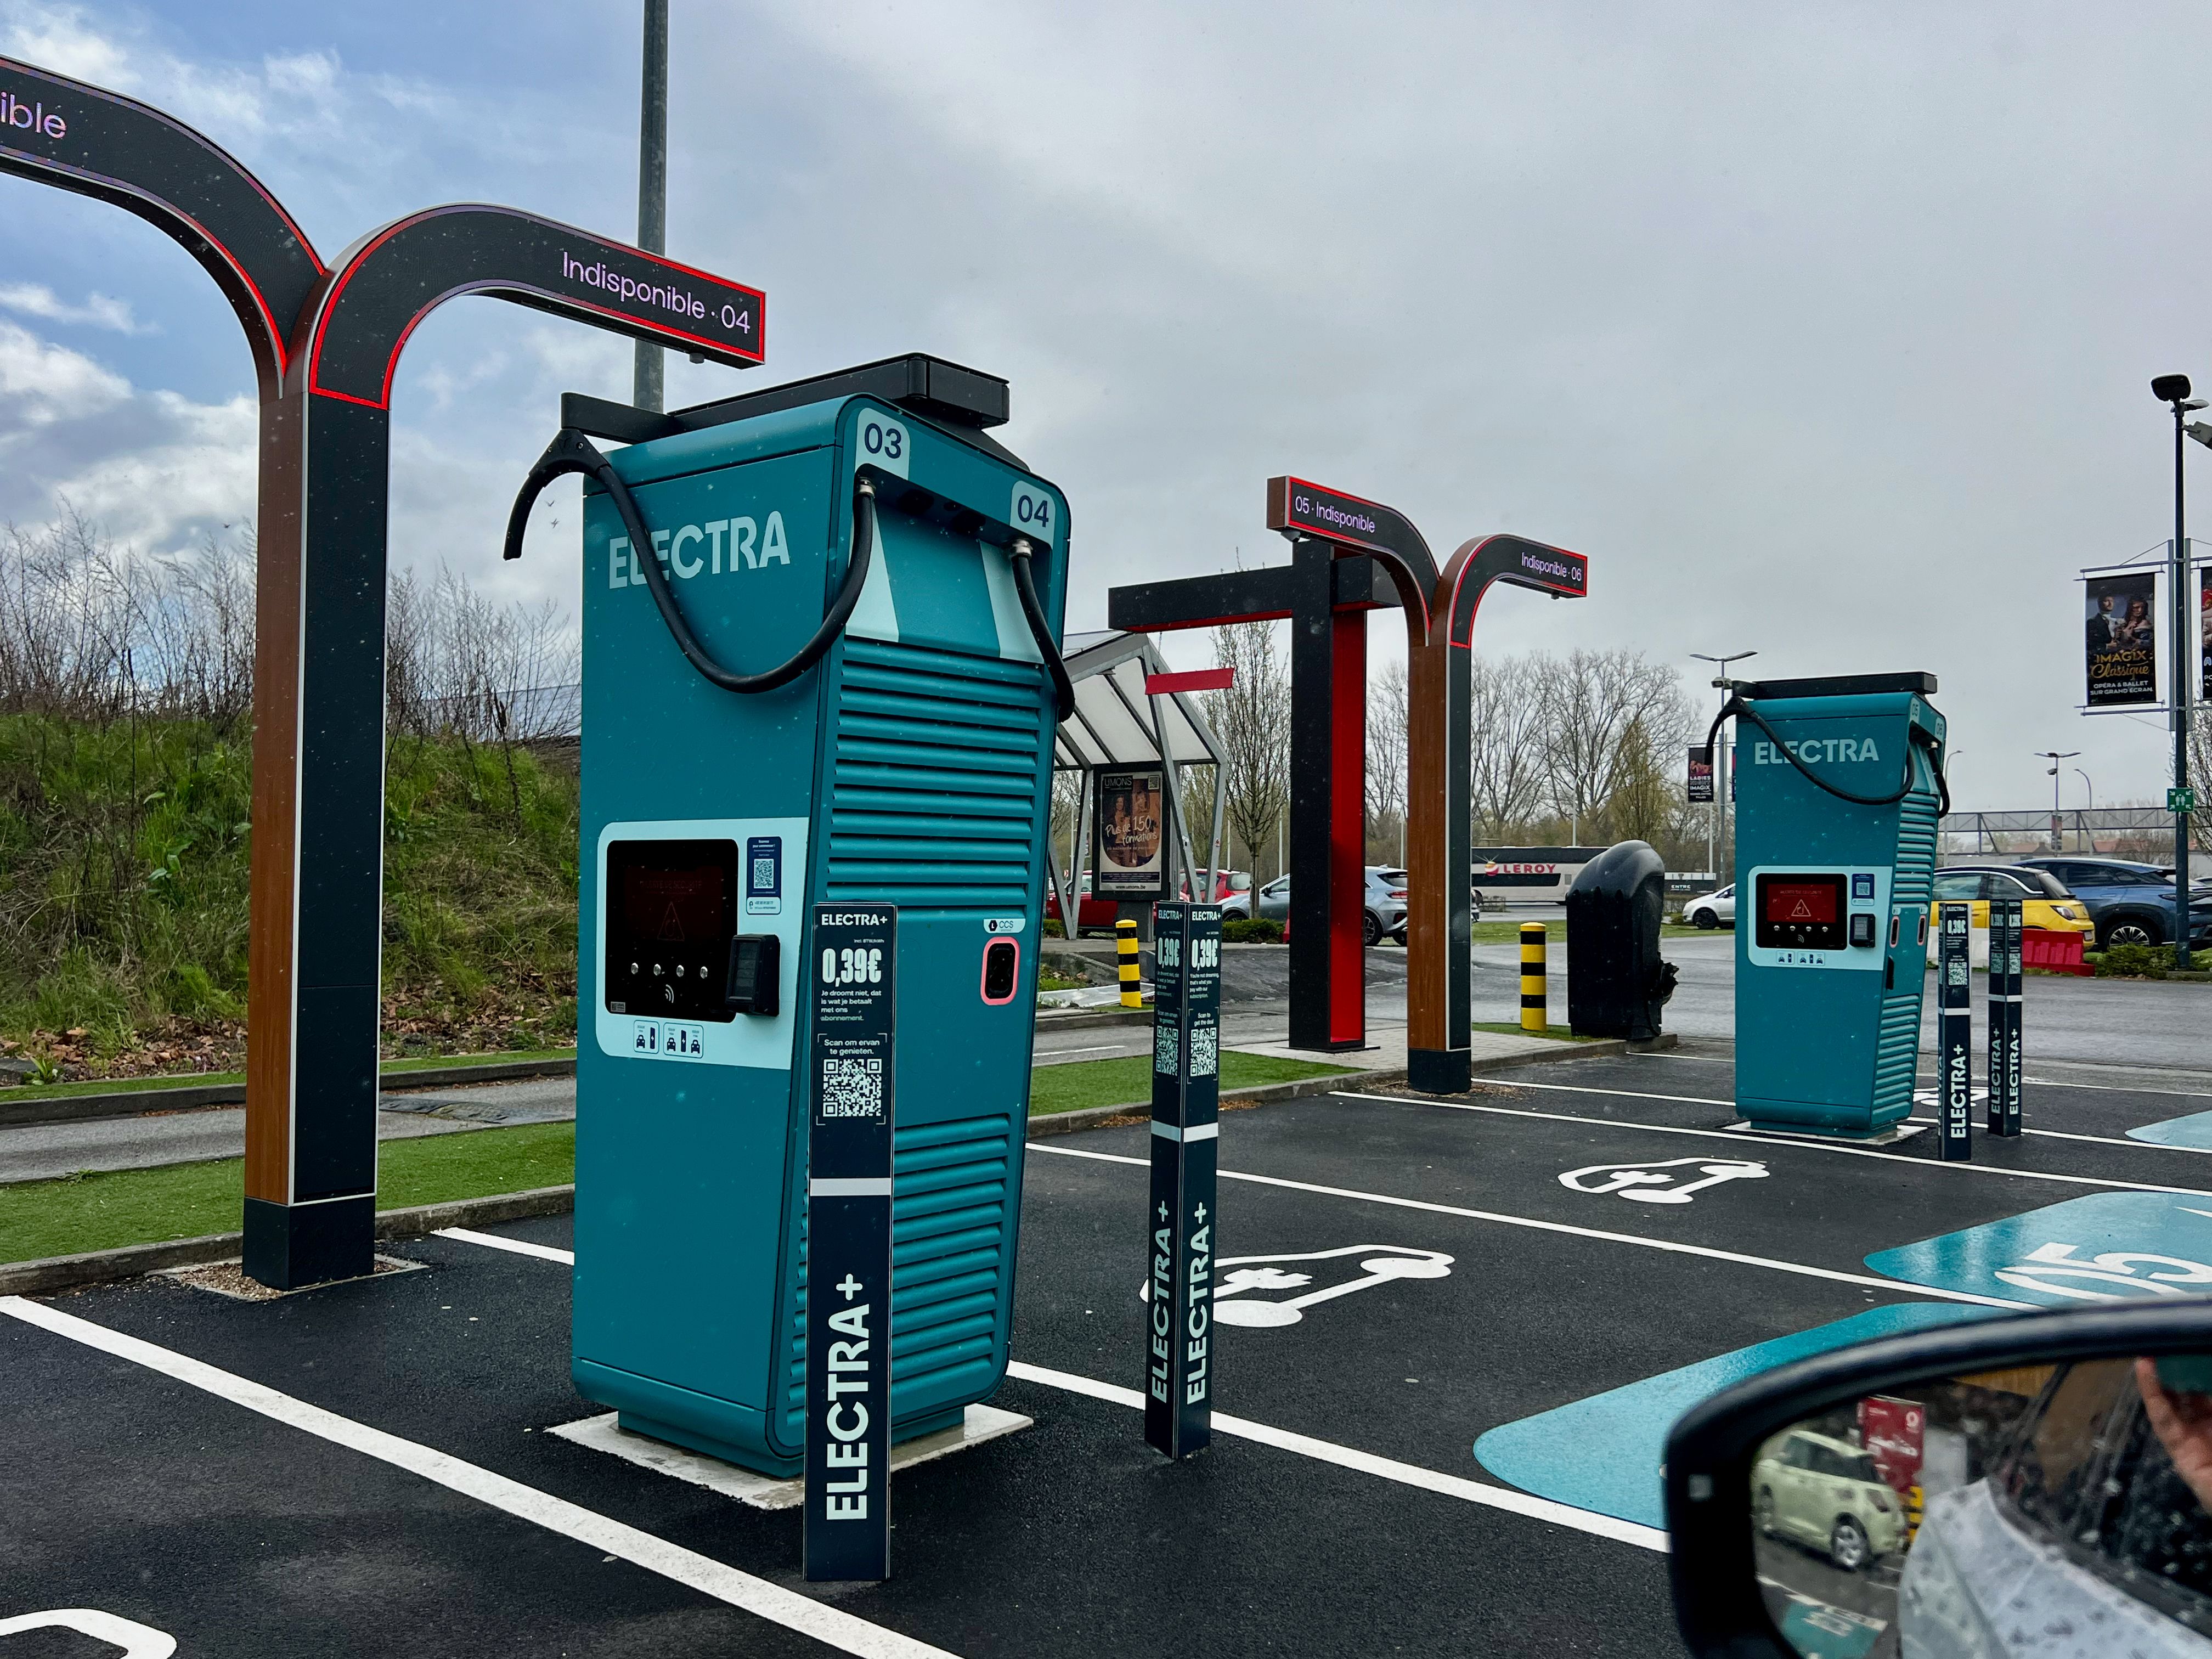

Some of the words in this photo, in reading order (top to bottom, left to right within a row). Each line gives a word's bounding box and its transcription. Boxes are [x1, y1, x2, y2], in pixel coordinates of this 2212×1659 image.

[563, 251, 706, 319] Indisponible
[721, 304, 751, 334] 04
[864, 422, 902, 459] 03
[1018, 495, 1049, 528] 04
[1295, 495, 1309, 514] 05
[1316, 501, 1375, 533] Indisponible
[609, 510, 791, 589] ELECTRA
[1521, 552, 1567, 578] Indisponible
[1571, 565, 1582, 582] 06
[2091, 663, 2149, 681] Classique
[2096, 649, 2147, 663] IMAGIX
[1755, 738, 1880, 764] ELECTRA
[1104, 777, 1132, 787] UMONS
[1105, 824, 1121, 837] Plus
[1122, 822, 1131, 833] de
[1133, 815, 1152, 831] 150
[1122, 830, 1158, 847] formations
[1503, 864, 1556, 874] LEROY
[821, 913, 888, 926] ELECTRA+
[1158, 910, 1183, 921] ELECTRA+
[1192, 911, 1221, 921] ELECTRA+
[822, 948, 882, 987] 0,39€
[1158, 937, 1180, 969] 0,39€
[1192, 939, 1218, 971] 0,39€
[839, 1048, 874, 1056] genieten.
[1991, 1028, 2001, 1114] ELECTRA+
[2009, 1028, 2019, 1115] ELECTRA+
[1951, 1044, 1966, 1138] ELECTRA+
[1152, 1200, 1171, 1404] ELECTRA+
[1187, 1201, 1209, 1405] ELECTRA+
[826, 1273, 870, 1520] ELECTRA+
